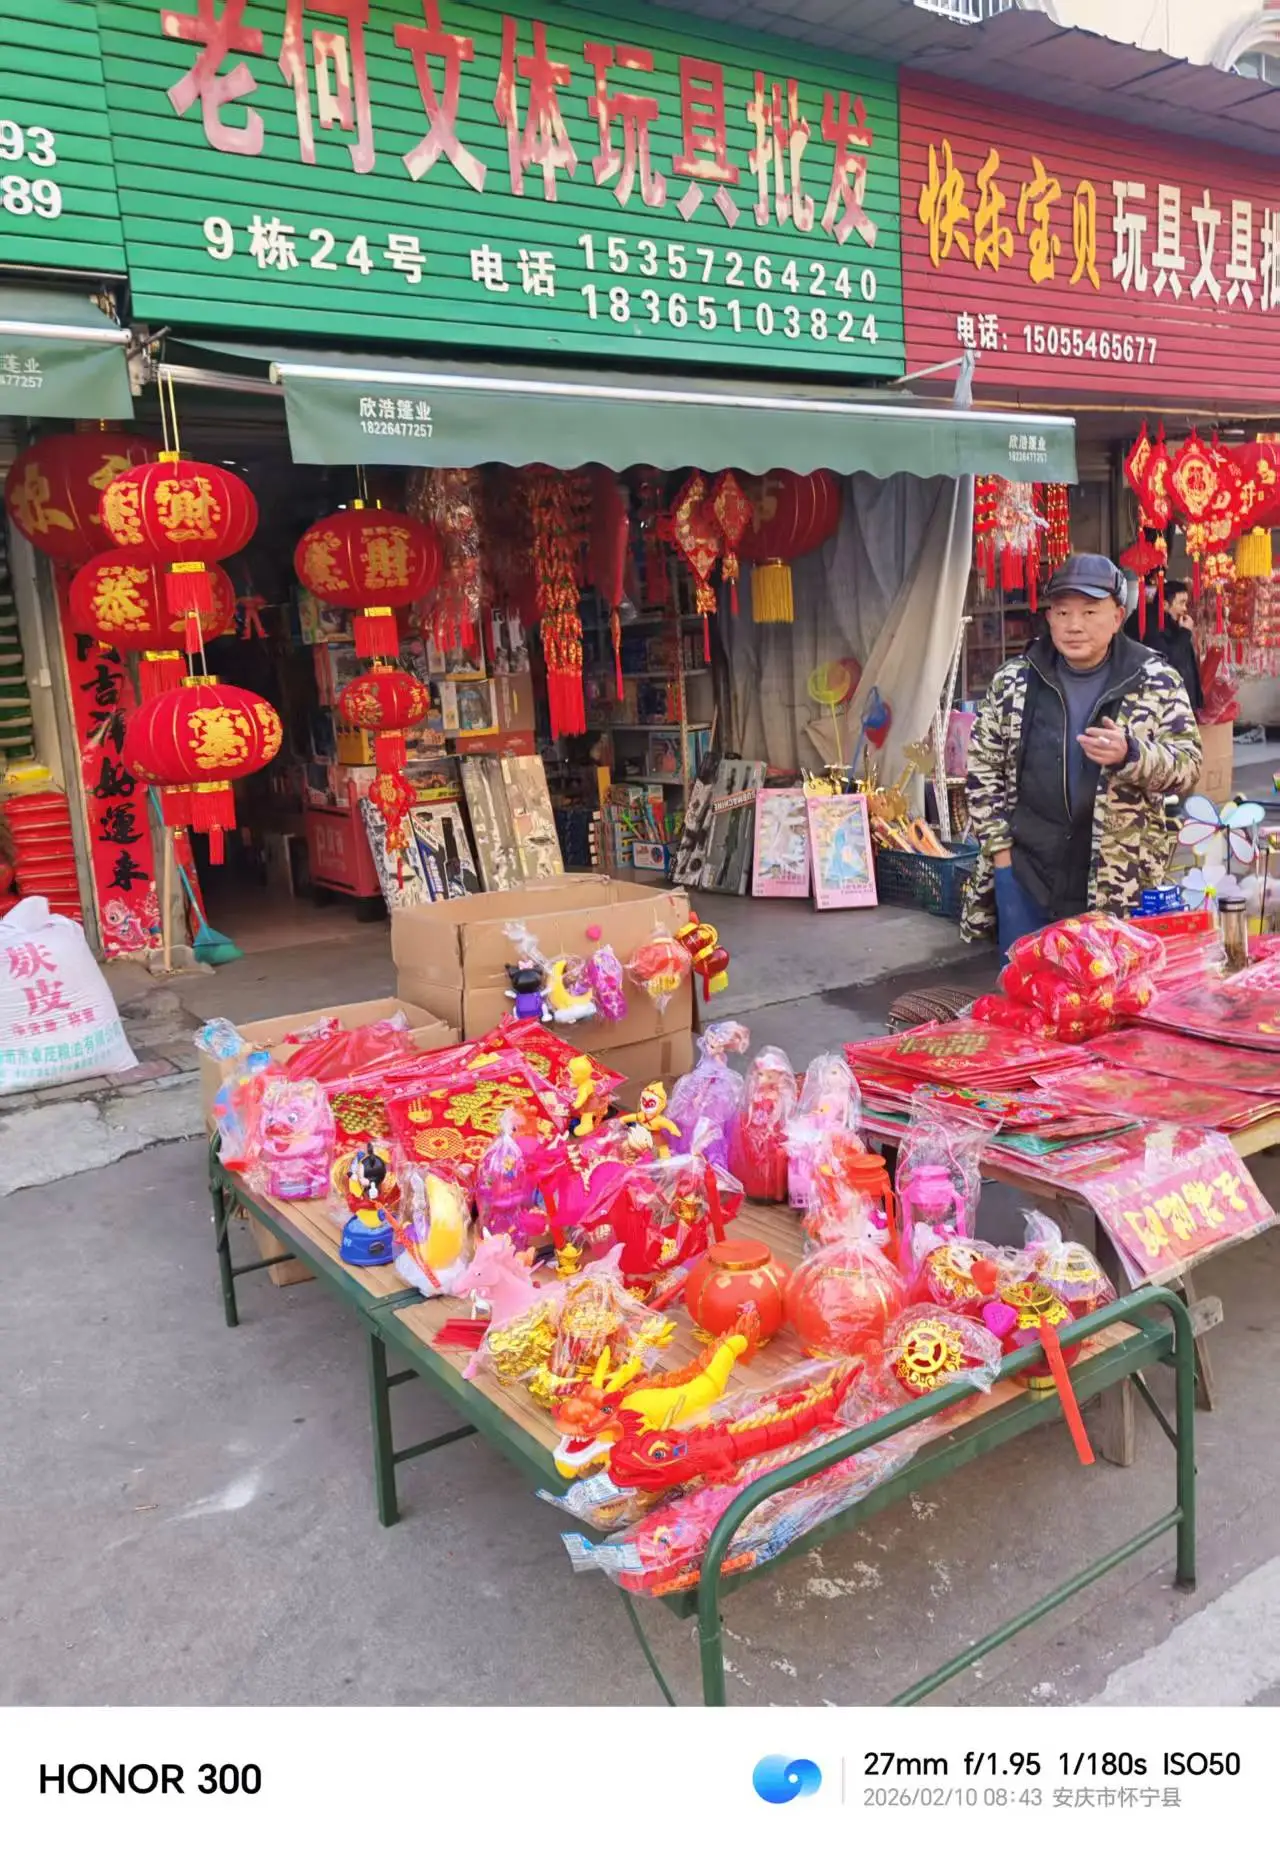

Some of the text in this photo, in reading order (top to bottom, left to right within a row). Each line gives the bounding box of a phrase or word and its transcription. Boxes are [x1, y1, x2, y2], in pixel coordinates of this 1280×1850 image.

[160, 0, 880, 248] 老何文体玩具批发
[203, 215, 878, 301] 9栋24号 电话 15357264240
[581, 283, 878, 345] 18365103824
[1023, 324, 1158, 365] 15055465677
[360, 420, 434, 438] 18226477257
